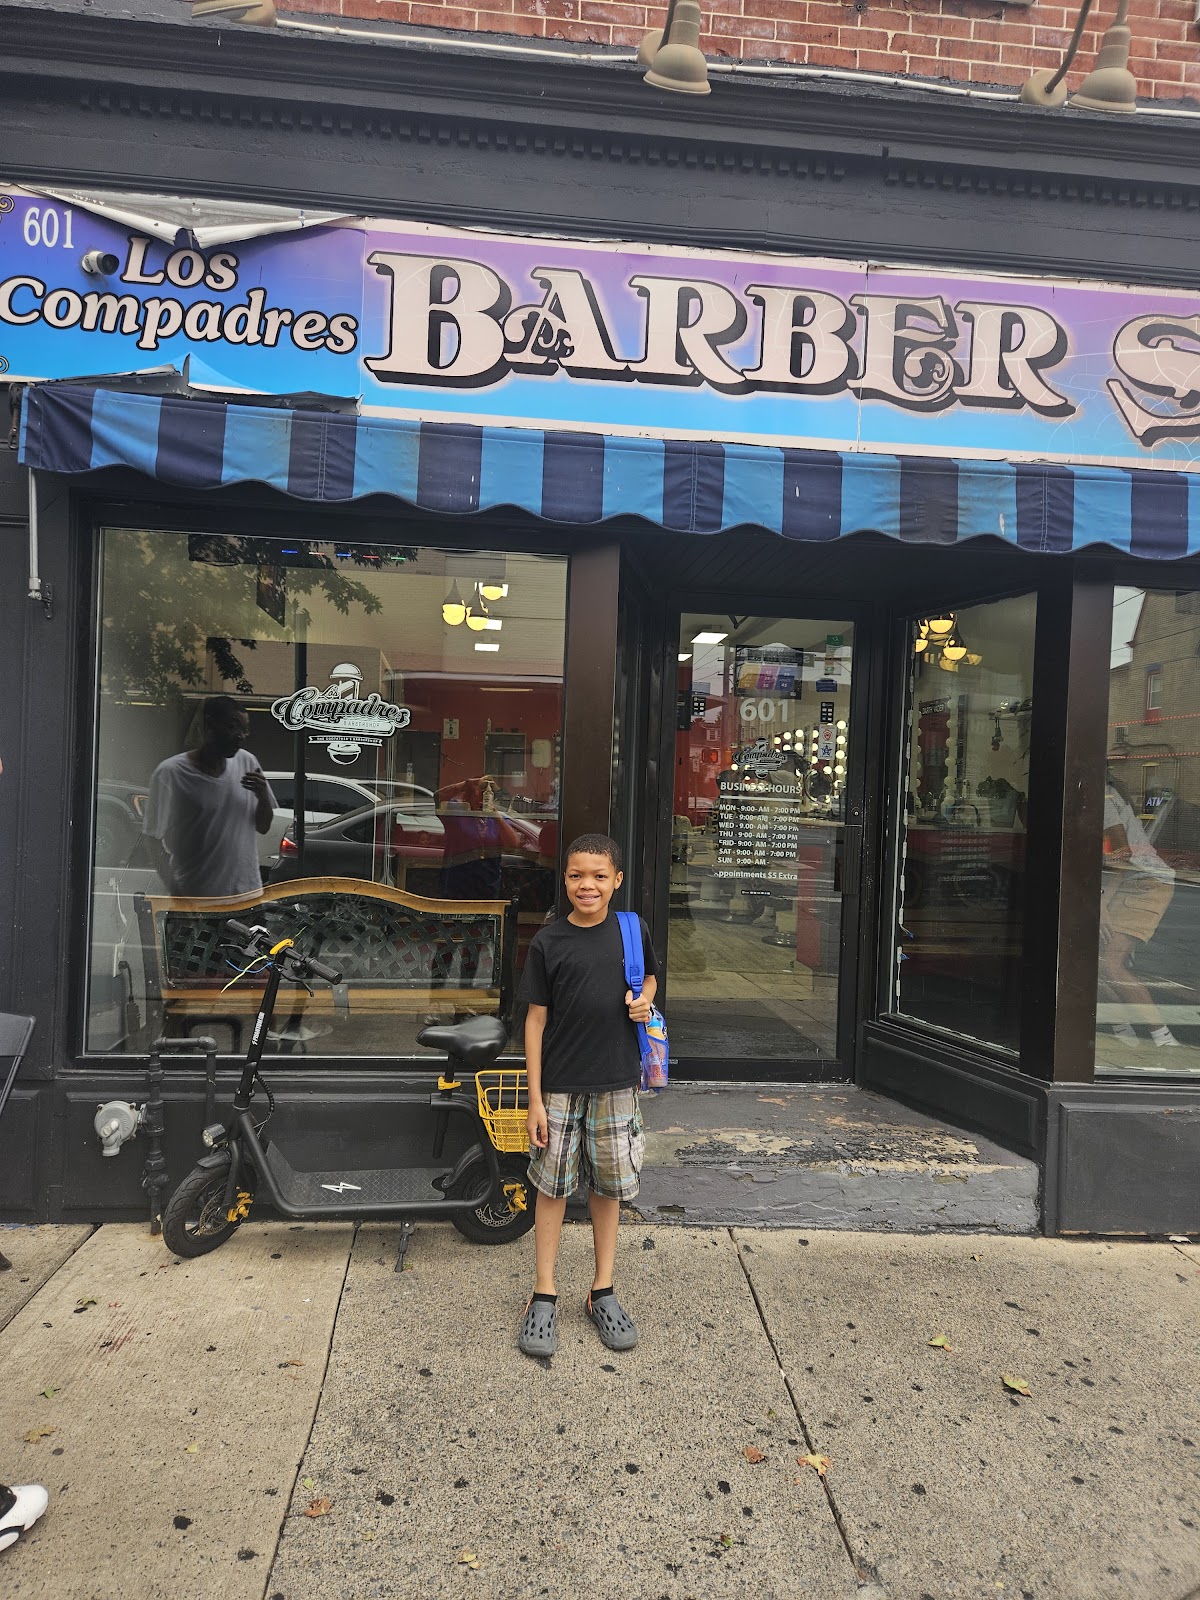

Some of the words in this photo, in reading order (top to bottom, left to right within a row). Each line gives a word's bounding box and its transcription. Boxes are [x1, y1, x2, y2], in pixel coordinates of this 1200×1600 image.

[23, 206, 74, 249] 601
[120, 236, 239, 291] Los
[0, 275, 358, 354] Compadres
[363, 250, 1076, 418] BARBER
[271, 687, 410, 729] Compadres
[322, 685, 339, 697] Los
[740, 698, 789, 722] 601
[720, 782, 766, 794] BUSINESS
[768, 784, 800, 794] HOURS
[778, 872, 798, 880] Extra
